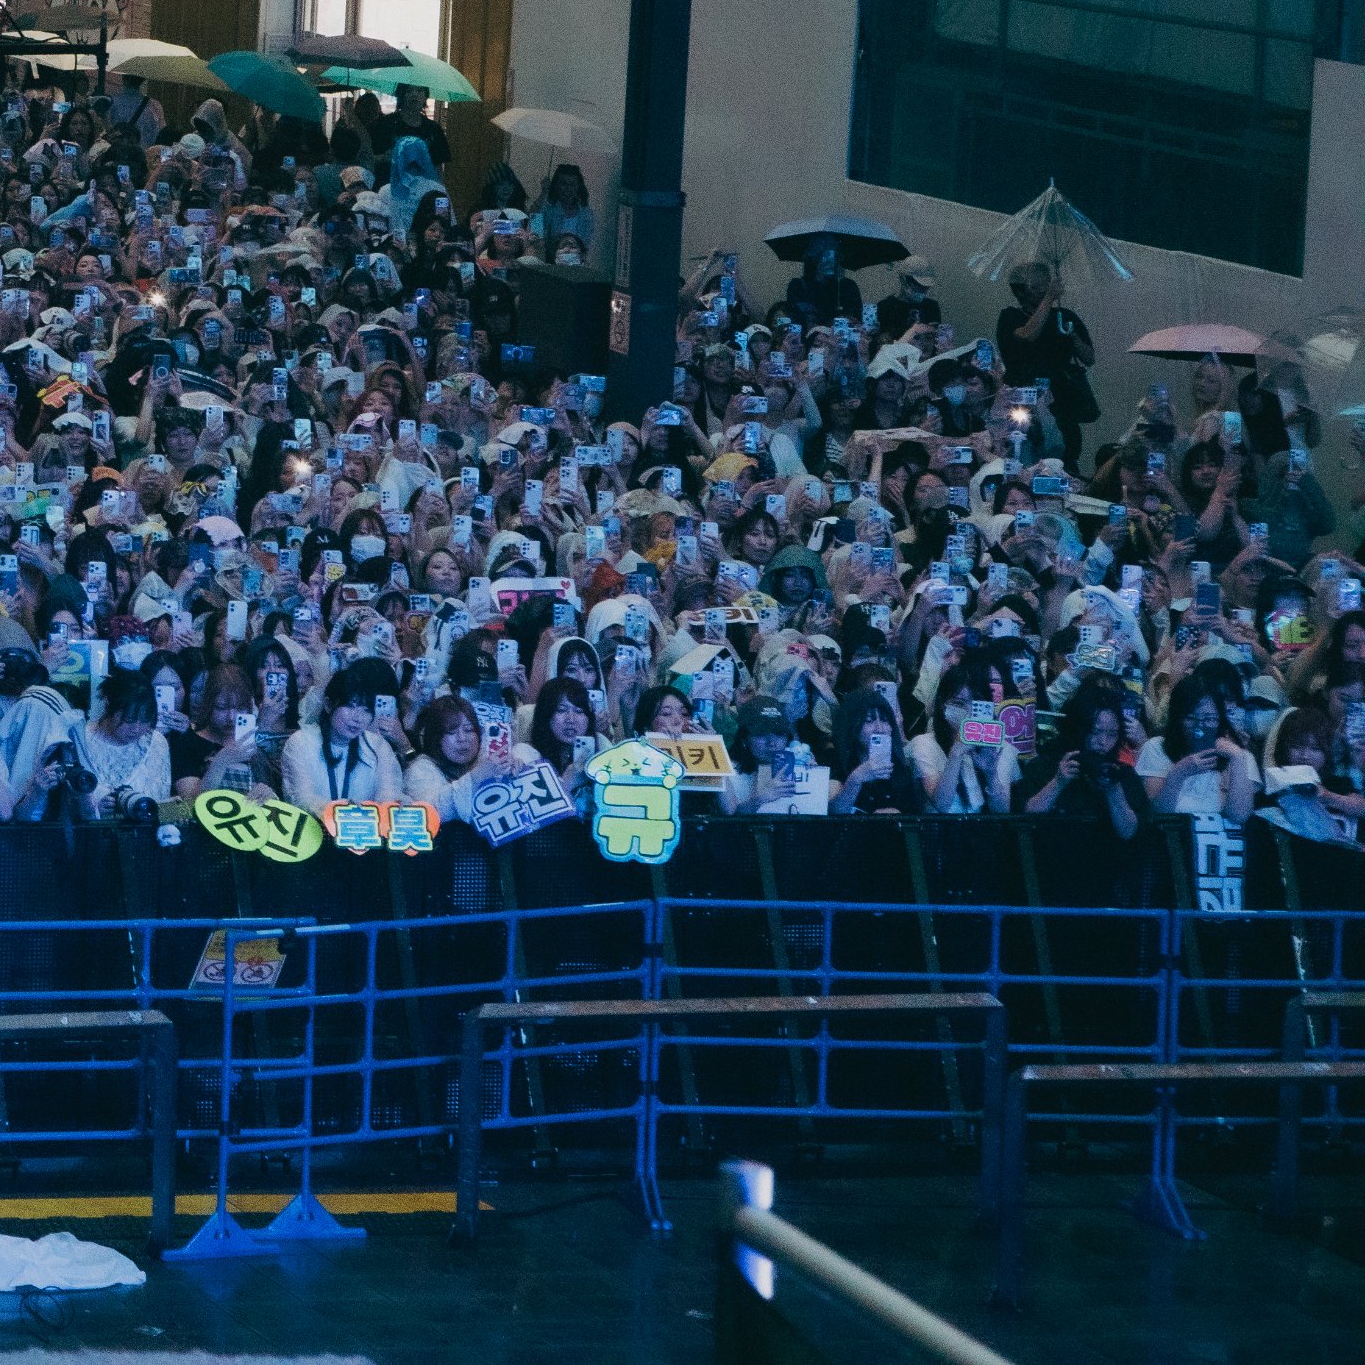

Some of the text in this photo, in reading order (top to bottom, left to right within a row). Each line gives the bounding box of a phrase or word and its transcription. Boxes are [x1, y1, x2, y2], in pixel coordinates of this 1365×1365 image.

[206, 795, 308, 858] 유진
[334, 804, 432, 851] 章昊
[473, 762, 570, 843] 유진
[604, 785, 675, 855] 규
